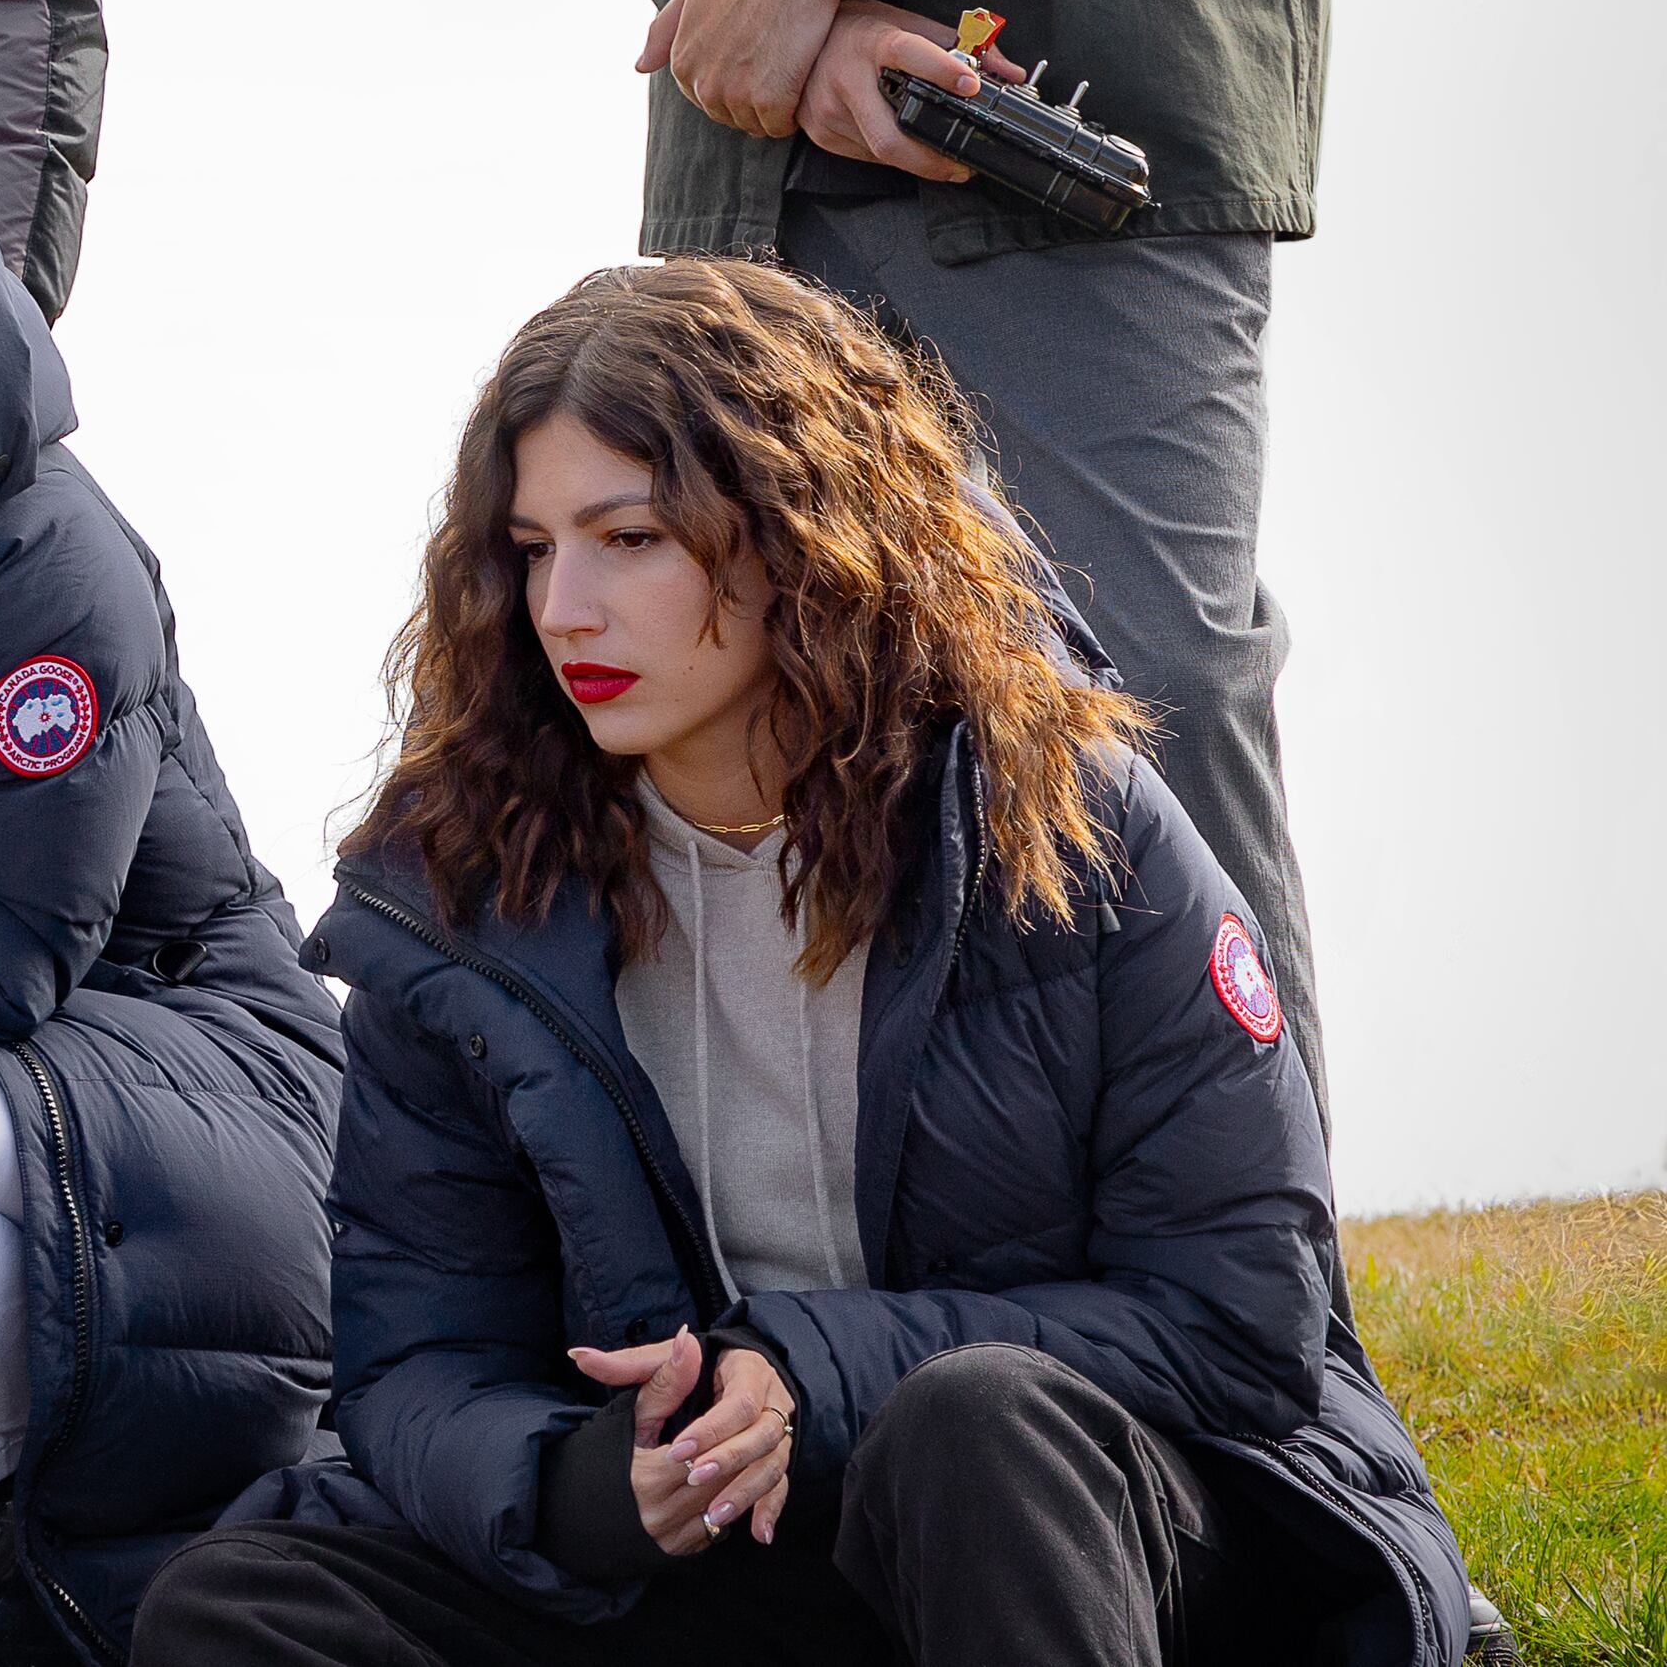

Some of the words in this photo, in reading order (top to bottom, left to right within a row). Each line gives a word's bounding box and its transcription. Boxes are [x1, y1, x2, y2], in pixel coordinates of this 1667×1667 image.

[0, 667, 38, 703] CANADA
[9, 749, 42, 769] ARCTIC
[43, 733, 86, 769] PROGRAM
